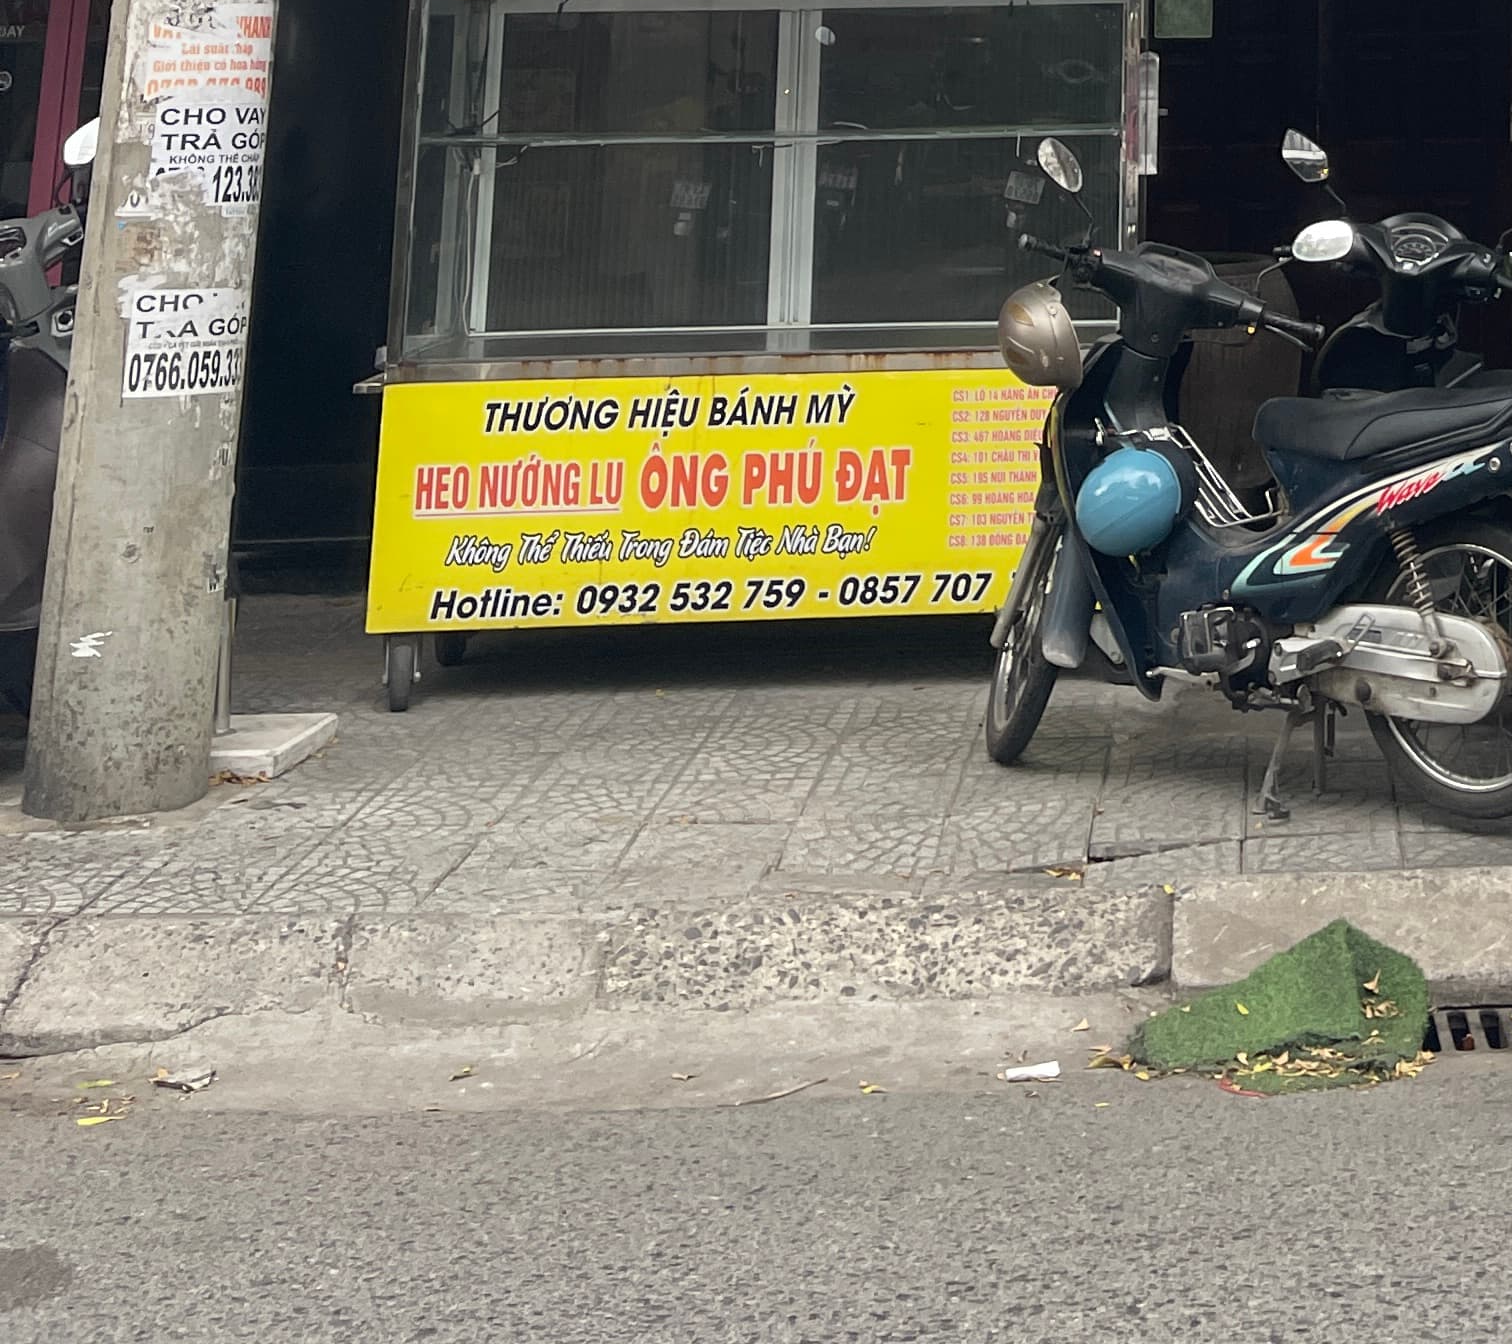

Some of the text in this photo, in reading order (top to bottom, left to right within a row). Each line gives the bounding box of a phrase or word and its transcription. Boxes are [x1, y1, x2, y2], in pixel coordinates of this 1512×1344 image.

[160, 108, 227, 126] CHO
[160, 128, 222, 151] TRẢ
[169, 153, 216, 165] KHÔNG
[483, 384, 855, 439] THƯƠNG HIỆU BÁNH MỲ
[414, 437, 912, 516] HEO NƯỚNG LU ÔNG PHÚ ĐẠT
[444, 532, 513, 572] Không
[616, 530, 672, 569] Trong
[678, 525, 730, 561] Đám
[775, 522, 820, 557] Nhà
[428, 589, 564, 622] Hotline:
[575, 583, 658, 614] 0932
[669, 581, 733, 613] 532
[742, 578, 806, 610] 759
[838, 575, 921, 606] 0857
[930, 573, 994, 603] 707
